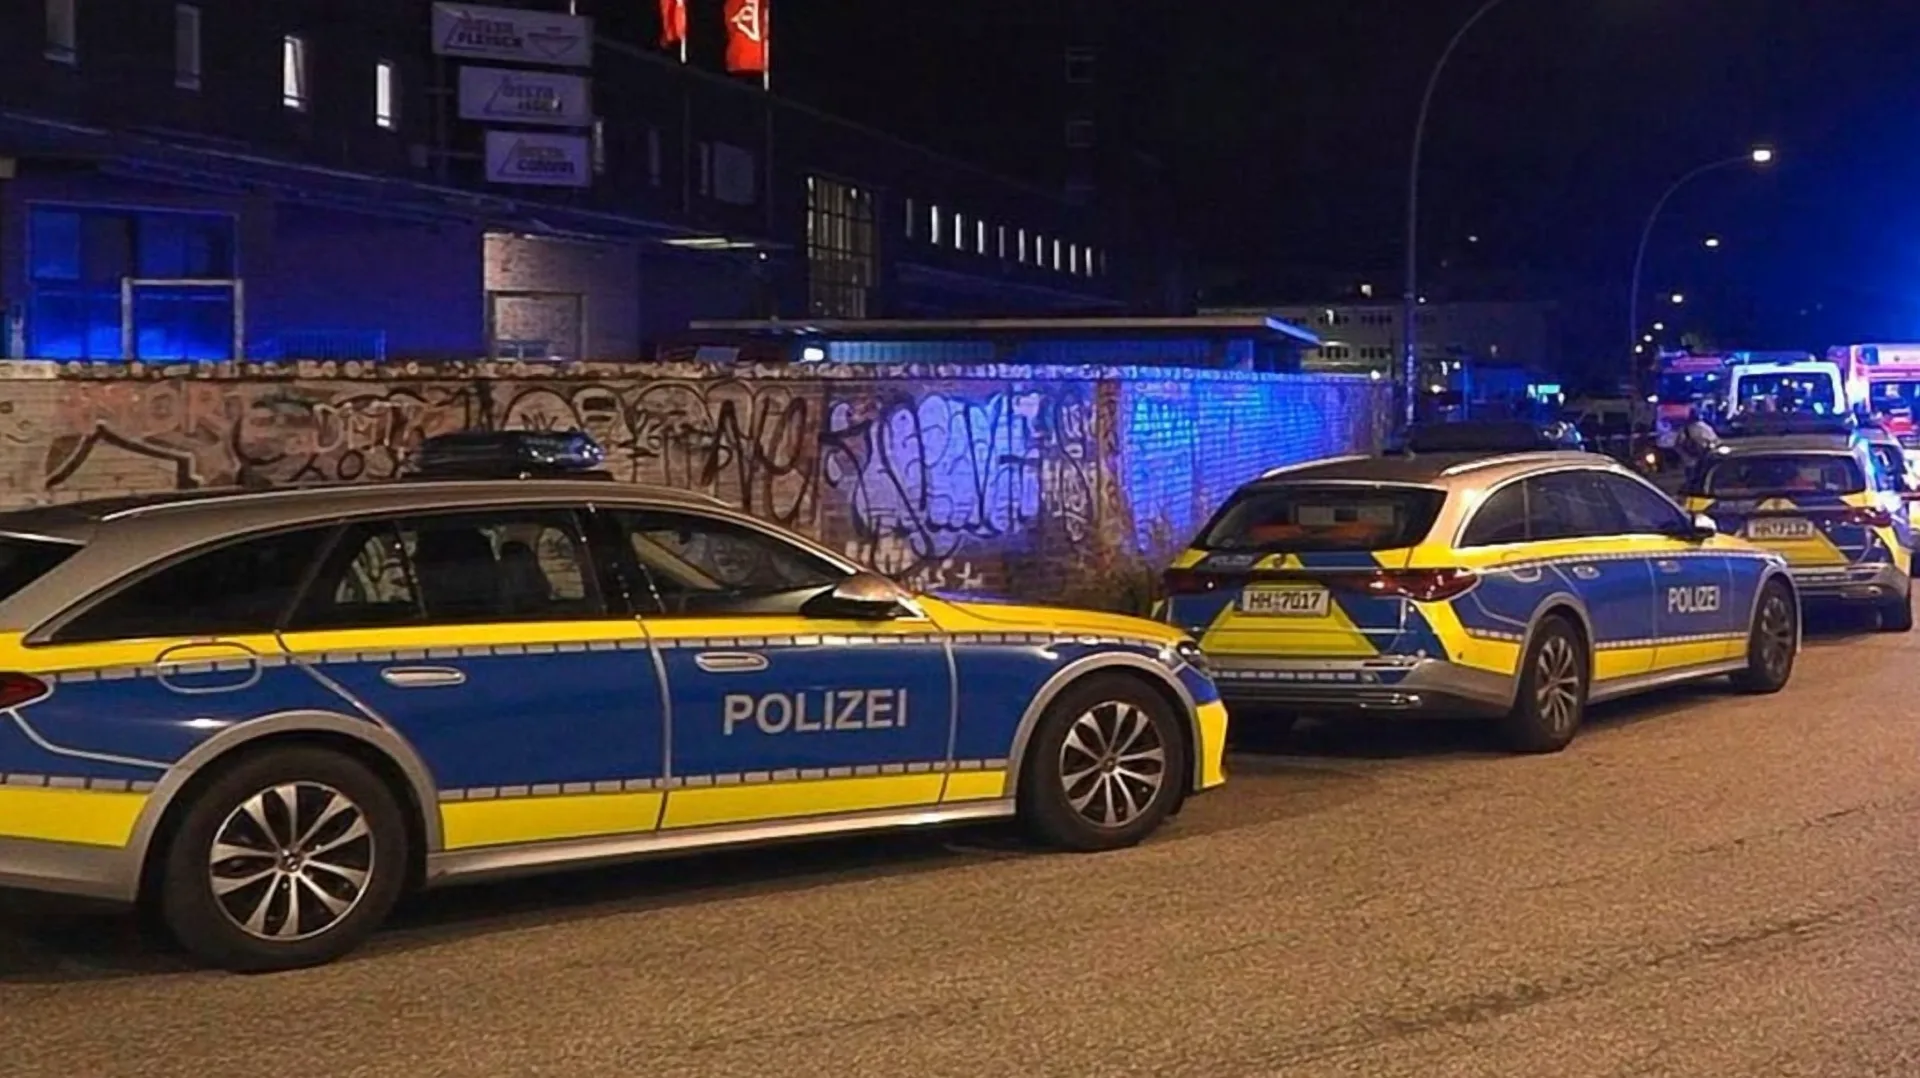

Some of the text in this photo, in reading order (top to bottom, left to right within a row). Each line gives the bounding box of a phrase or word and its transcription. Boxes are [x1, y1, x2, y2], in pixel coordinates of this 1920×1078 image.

[1249, 592, 1321, 610] HH 7017
[1667, 585, 1721, 614] POLIZEI
[722, 687, 908, 736] POLIZEI
